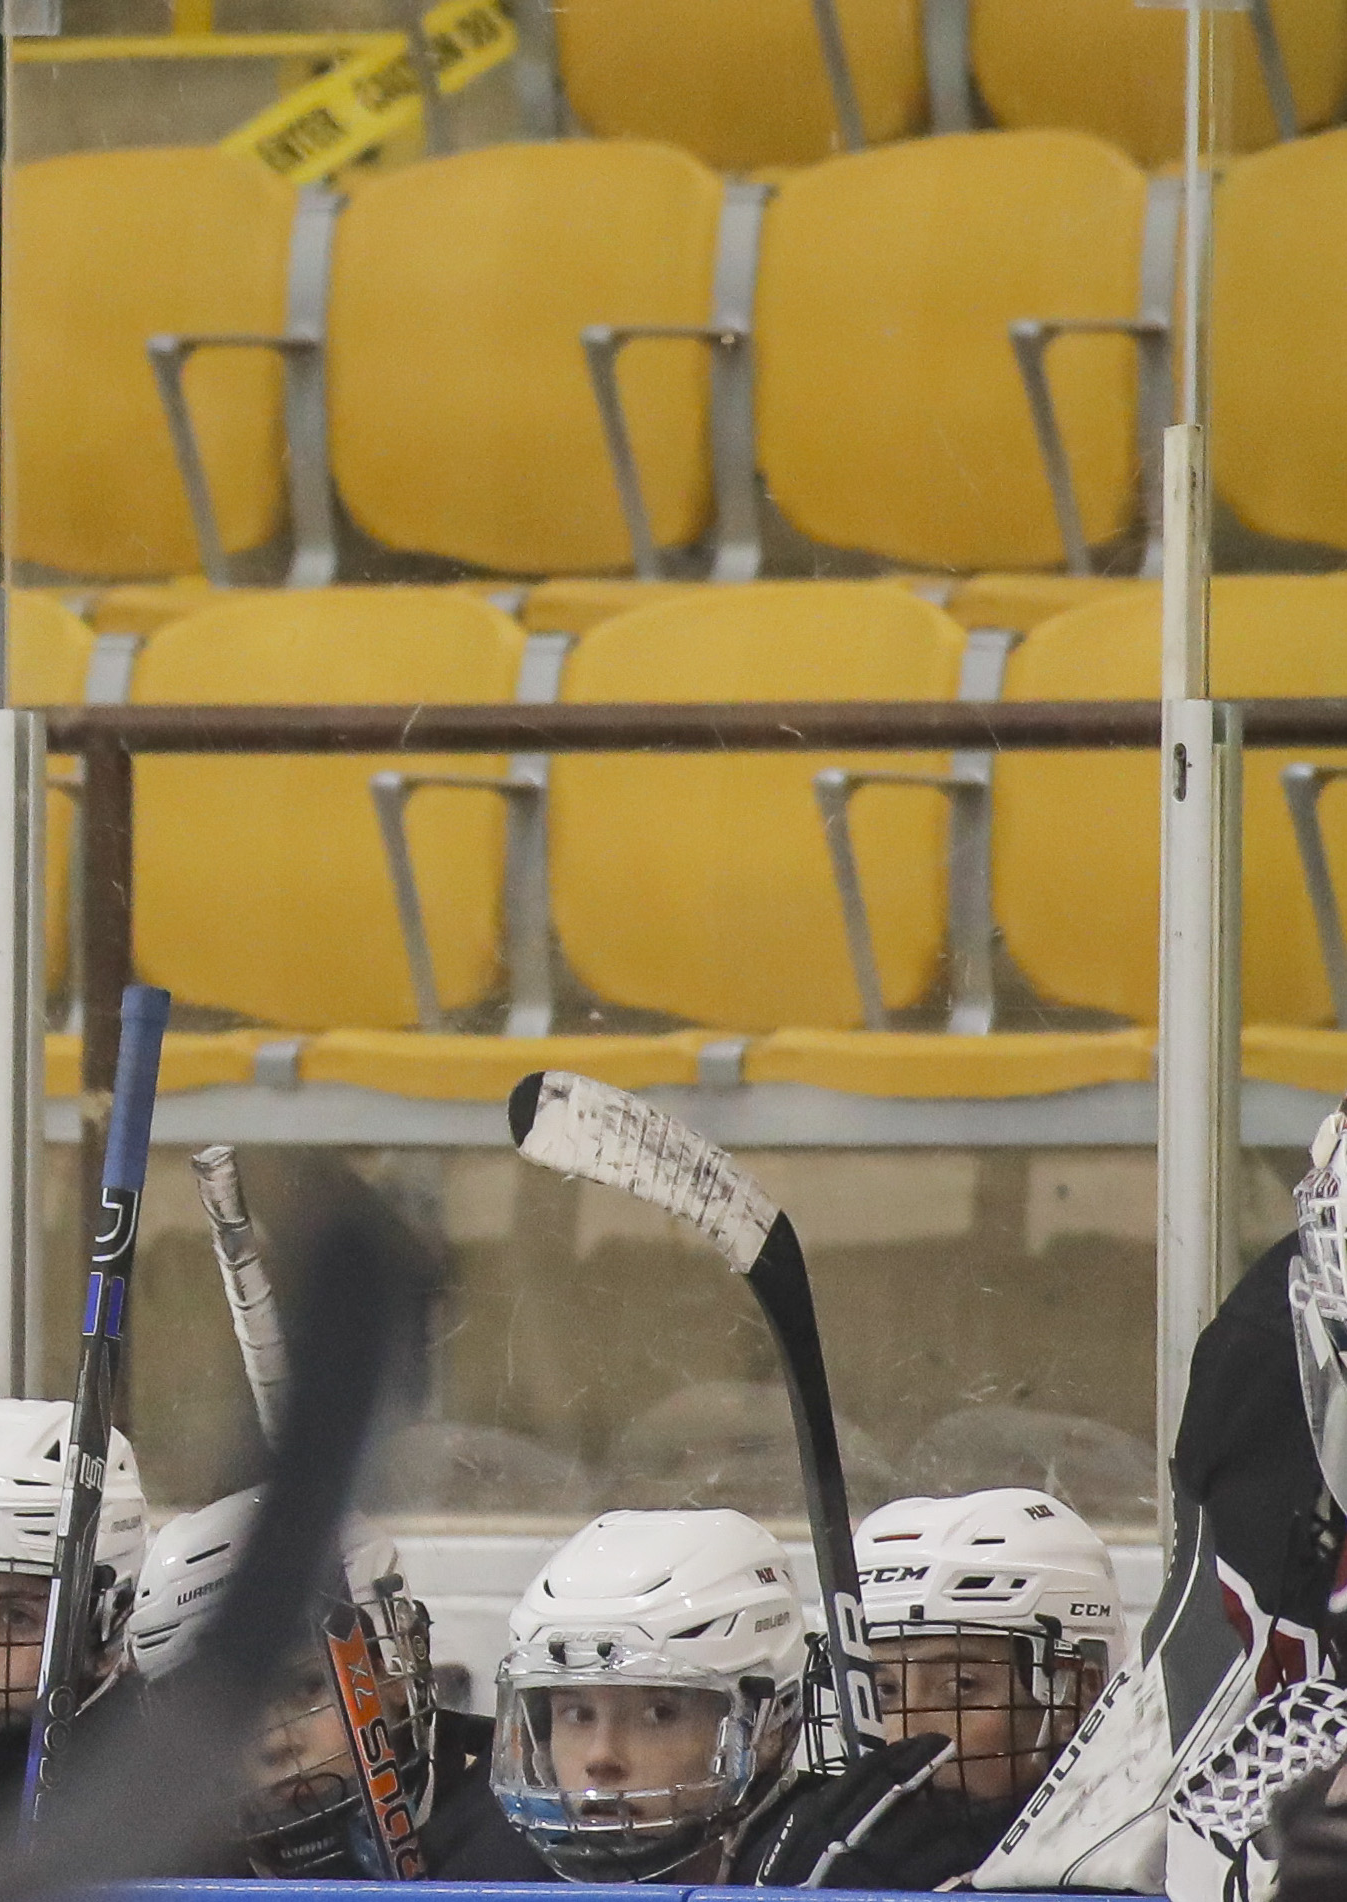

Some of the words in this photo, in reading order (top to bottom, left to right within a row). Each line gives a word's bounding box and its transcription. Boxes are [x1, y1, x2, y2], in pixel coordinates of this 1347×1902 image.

[858, 1565, 932, 1585] CCM
[1069, 1602, 1112, 1617] CCM
[1001, 1671, 1132, 1856] BAUER
